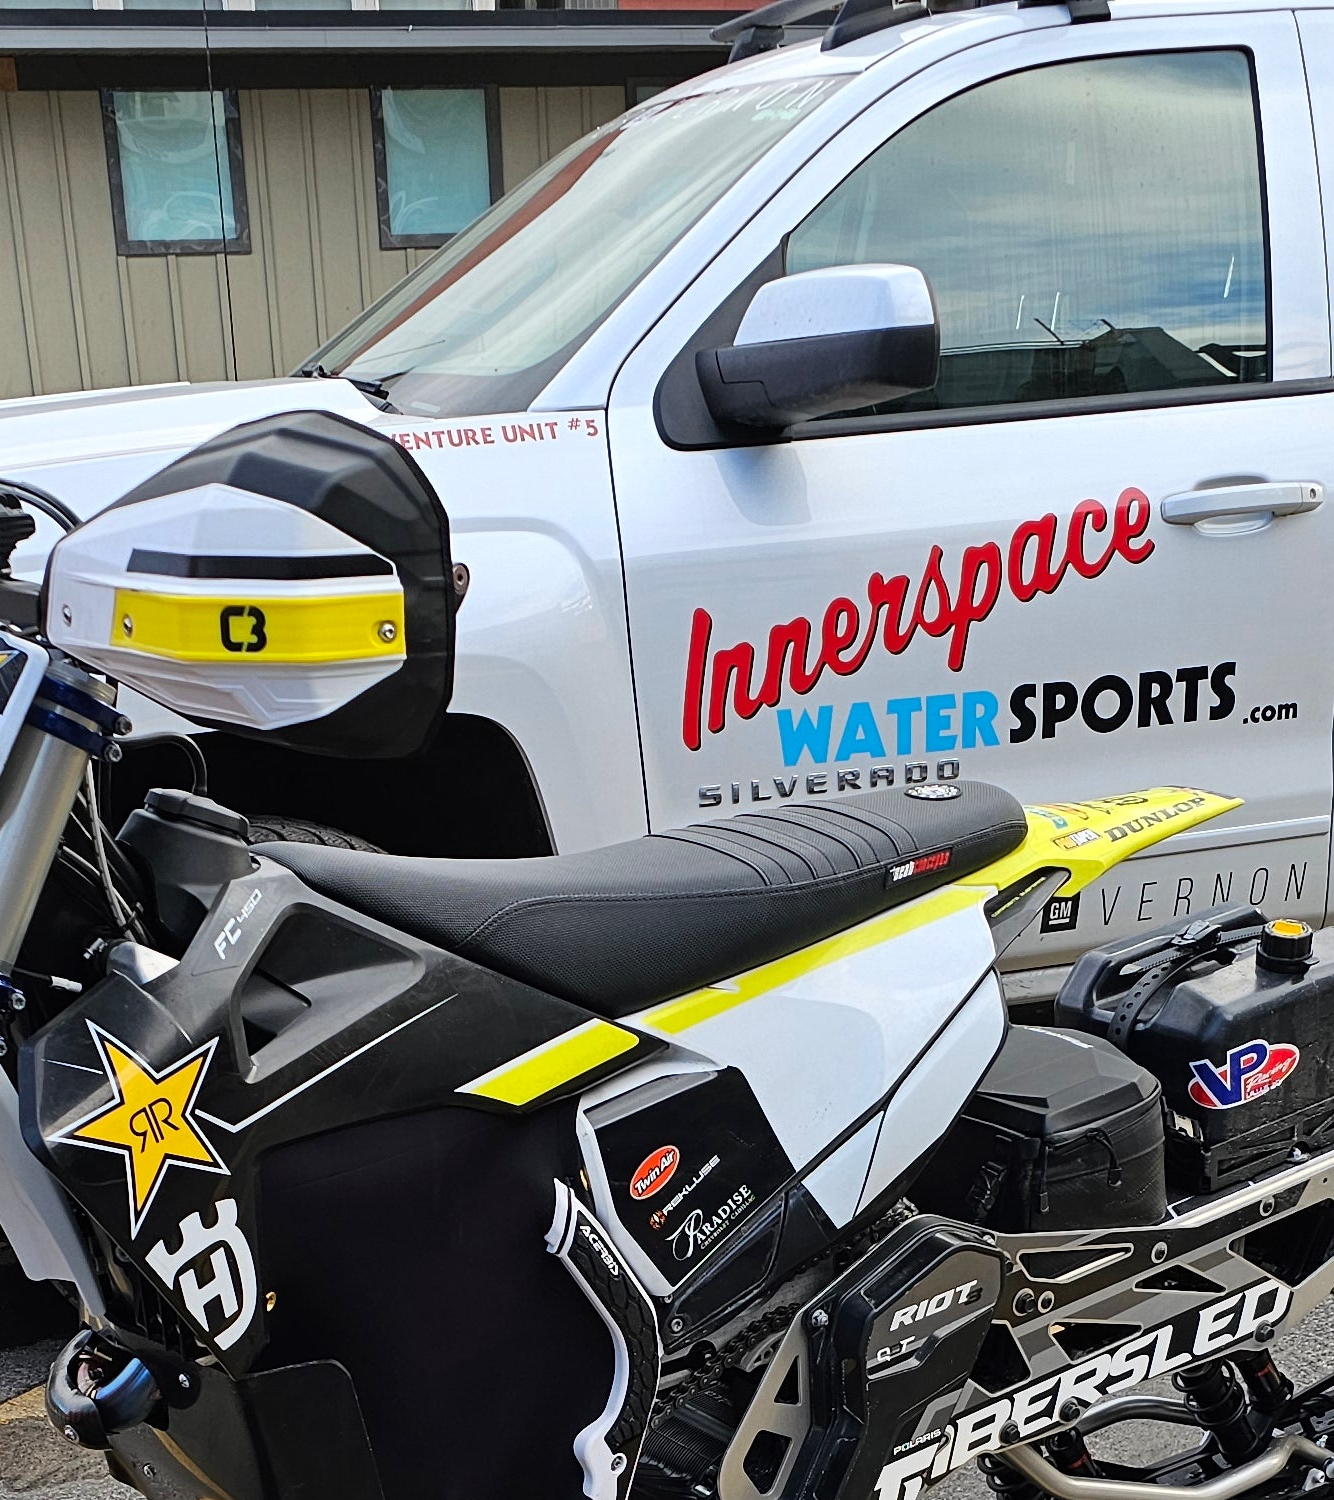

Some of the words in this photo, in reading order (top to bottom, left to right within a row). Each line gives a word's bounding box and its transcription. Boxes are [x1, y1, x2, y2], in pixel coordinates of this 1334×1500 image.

[501, 421, 558, 442] UNIT
[682, 487, 1155, 751] Innerspace
[699, 759, 961, 808] SILVERADO
[1104, 797, 1206, 842] DUNLOP
[236, 888, 263, 923] 450
[1049, 900, 1073, 921] GM
[1101, 861, 1308, 926] VERNON
[634, 1168, 661, 1195] Twin
[659, 1149, 675, 1172] Air
[662, 1154, 721, 1216] REKLUSE
[889, 1279, 978, 1332] RIOT
[893, 1428, 942, 1455] POLARIS
